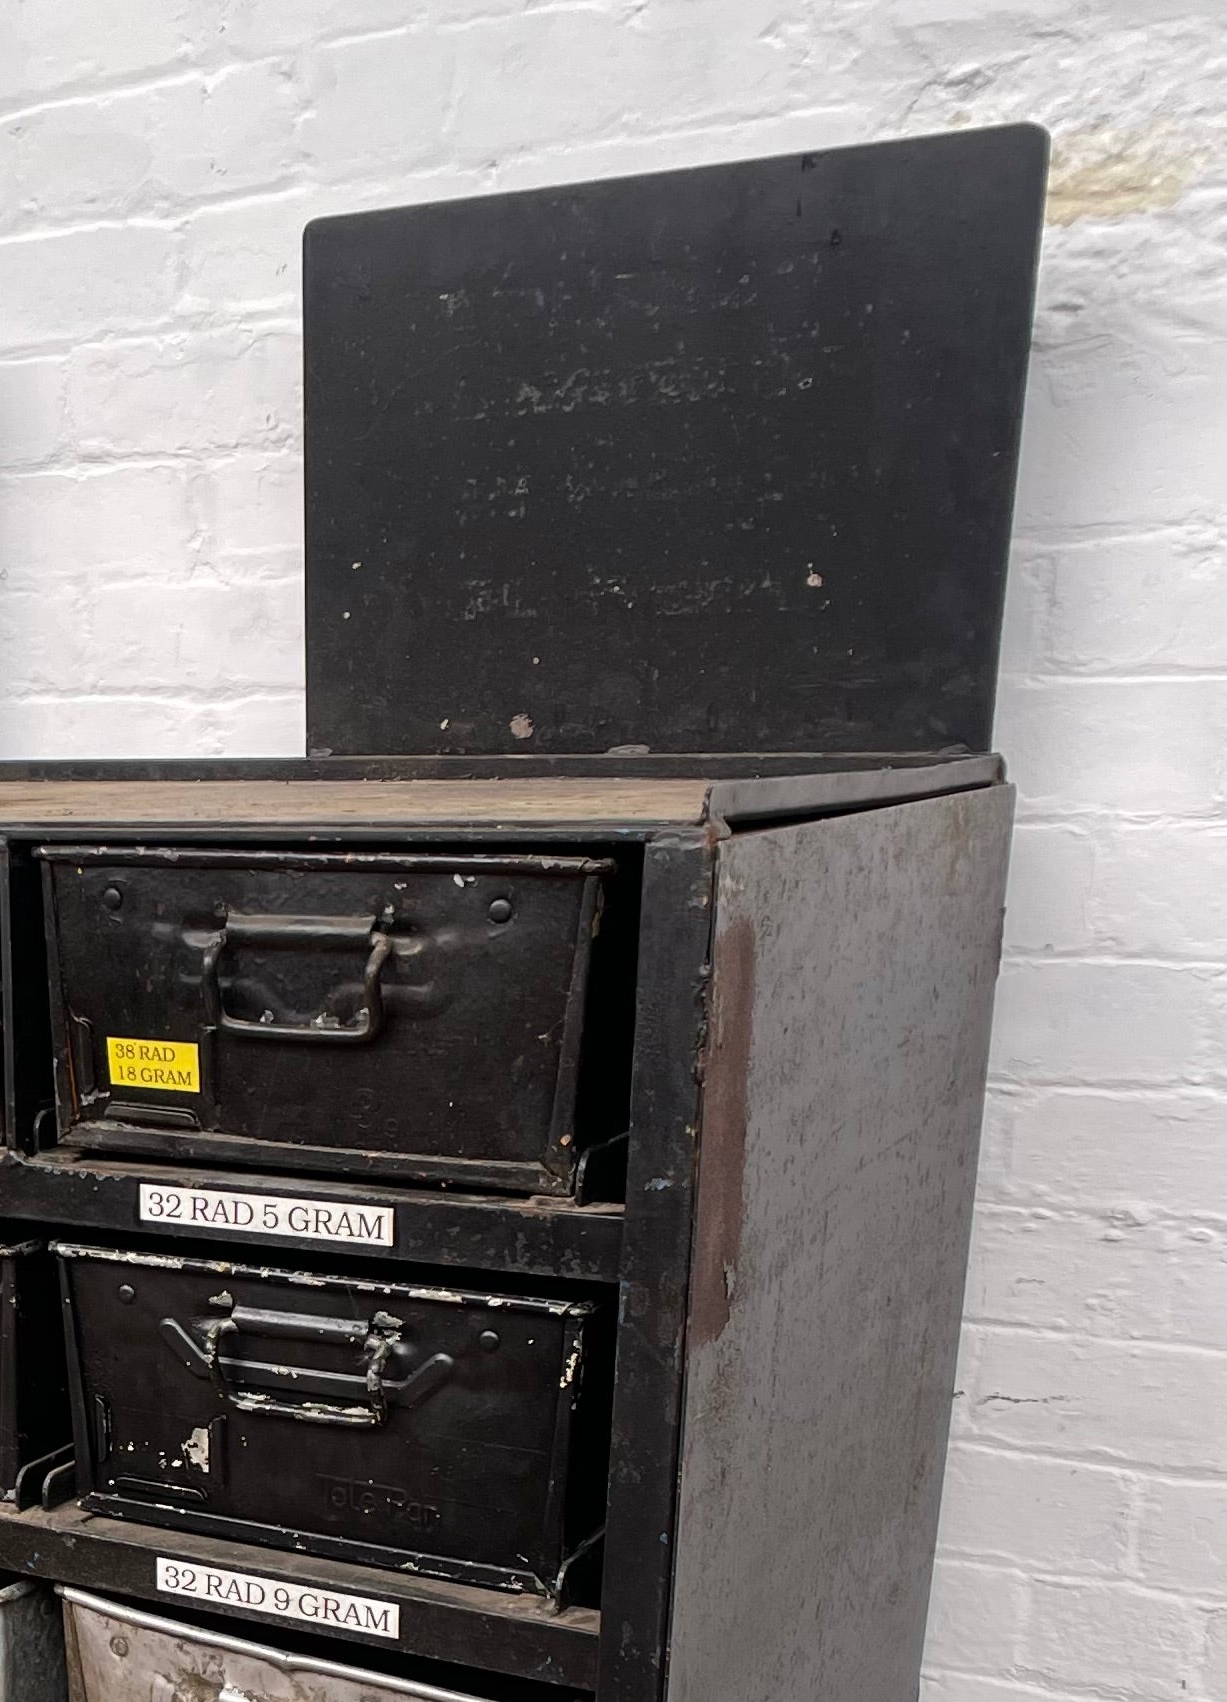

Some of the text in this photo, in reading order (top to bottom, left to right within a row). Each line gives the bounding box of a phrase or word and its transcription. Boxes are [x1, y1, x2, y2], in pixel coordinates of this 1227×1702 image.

[115, 1043, 176, 1062] 38 RAD
[119, 1065, 192, 1086] 18 GRAM
[148, 1192, 385, 1240] 32 RAD 5 GRAM
[165, 1566, 391, 1632] 32 RAD 9 GRAM
